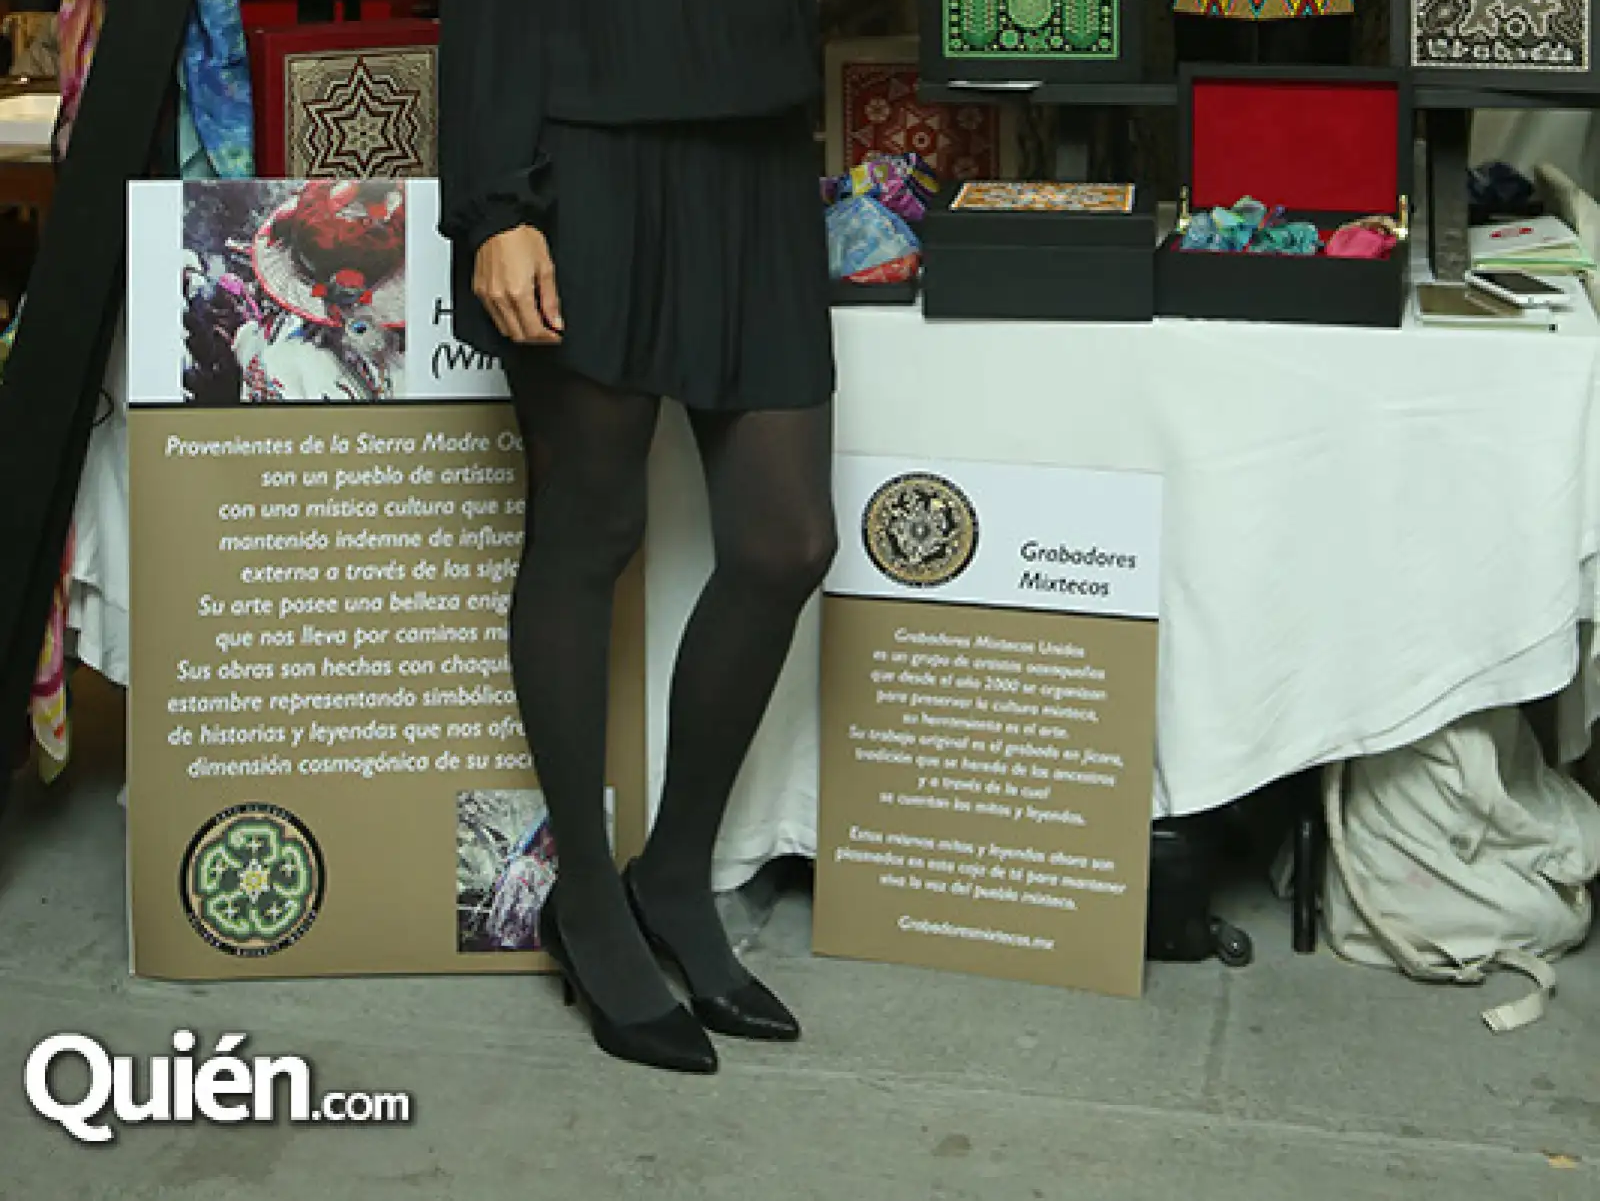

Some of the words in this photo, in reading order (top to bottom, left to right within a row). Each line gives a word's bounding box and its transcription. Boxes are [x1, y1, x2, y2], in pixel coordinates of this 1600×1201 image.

[165, 435, 294, 456] Provenientes
[299, 435, 324, 454] de
[330, 434, 350, 453] la
[356, 432, 416, 454] Sierra
[421, 432, 489, 452] Madre
[261, 471, 297, 487] son
[303, 471, 328, 486] un
[334, 465, 404, 490] pueblo
[408, 465, 435, 484] de
[441, 464, 514, 483] artistas
[219, 504, 255, 520] con
[261, 504, 300, 519] una
[384, 497, 455, 517] cultura
[461, 501, 498, 519] que
[219, 529, 330, 551] mantenido
[335, 529, 423, 549] indemne
[429, 527, 453, 547] de
[1020, 540, 1138, 569] Grabadores
[240, 565, 320, 583] externa
[324, 567, 339, 580] a
[411, 559, 438, 580] de
[443, 559, 471, 579] los
[1018, 572, 1111, 596] Mixtecos
[198, 594, 225, 616] Su
[231, 598, 273, 616] arte
[279, 597, 339, 619] posee
[345, 597, 384, 612] una
[390, 592, 460, 612] belleza
[216, 631, 253, 652] que
[259, 630, 294, 646] nos
[300, 625, 348, 646] lleva
[354, 627, 390, 649] por
[394, 625, 478, 643] caminos
[177, 659, 211, 682] Sus
[216, 660, 274, 679] obras
[280, 662, 315, 679] son
[321, 655, 393, 676] hechas
[399, 660, 435, 676] con
[168, 691, 264, 714] estambre
[270, 687, 417, 715] representando
[168, 725, 192, 745] de
[200, 724, 285, 745] historias
[291, 727, 305, 747] y
[309, 720, 397, 745] leyendas
[402, 723, 441, 743] que
[447, 722, 482, 738] nos
[435, 751, 460, 771] de
[465, 754, 489, 769] su
